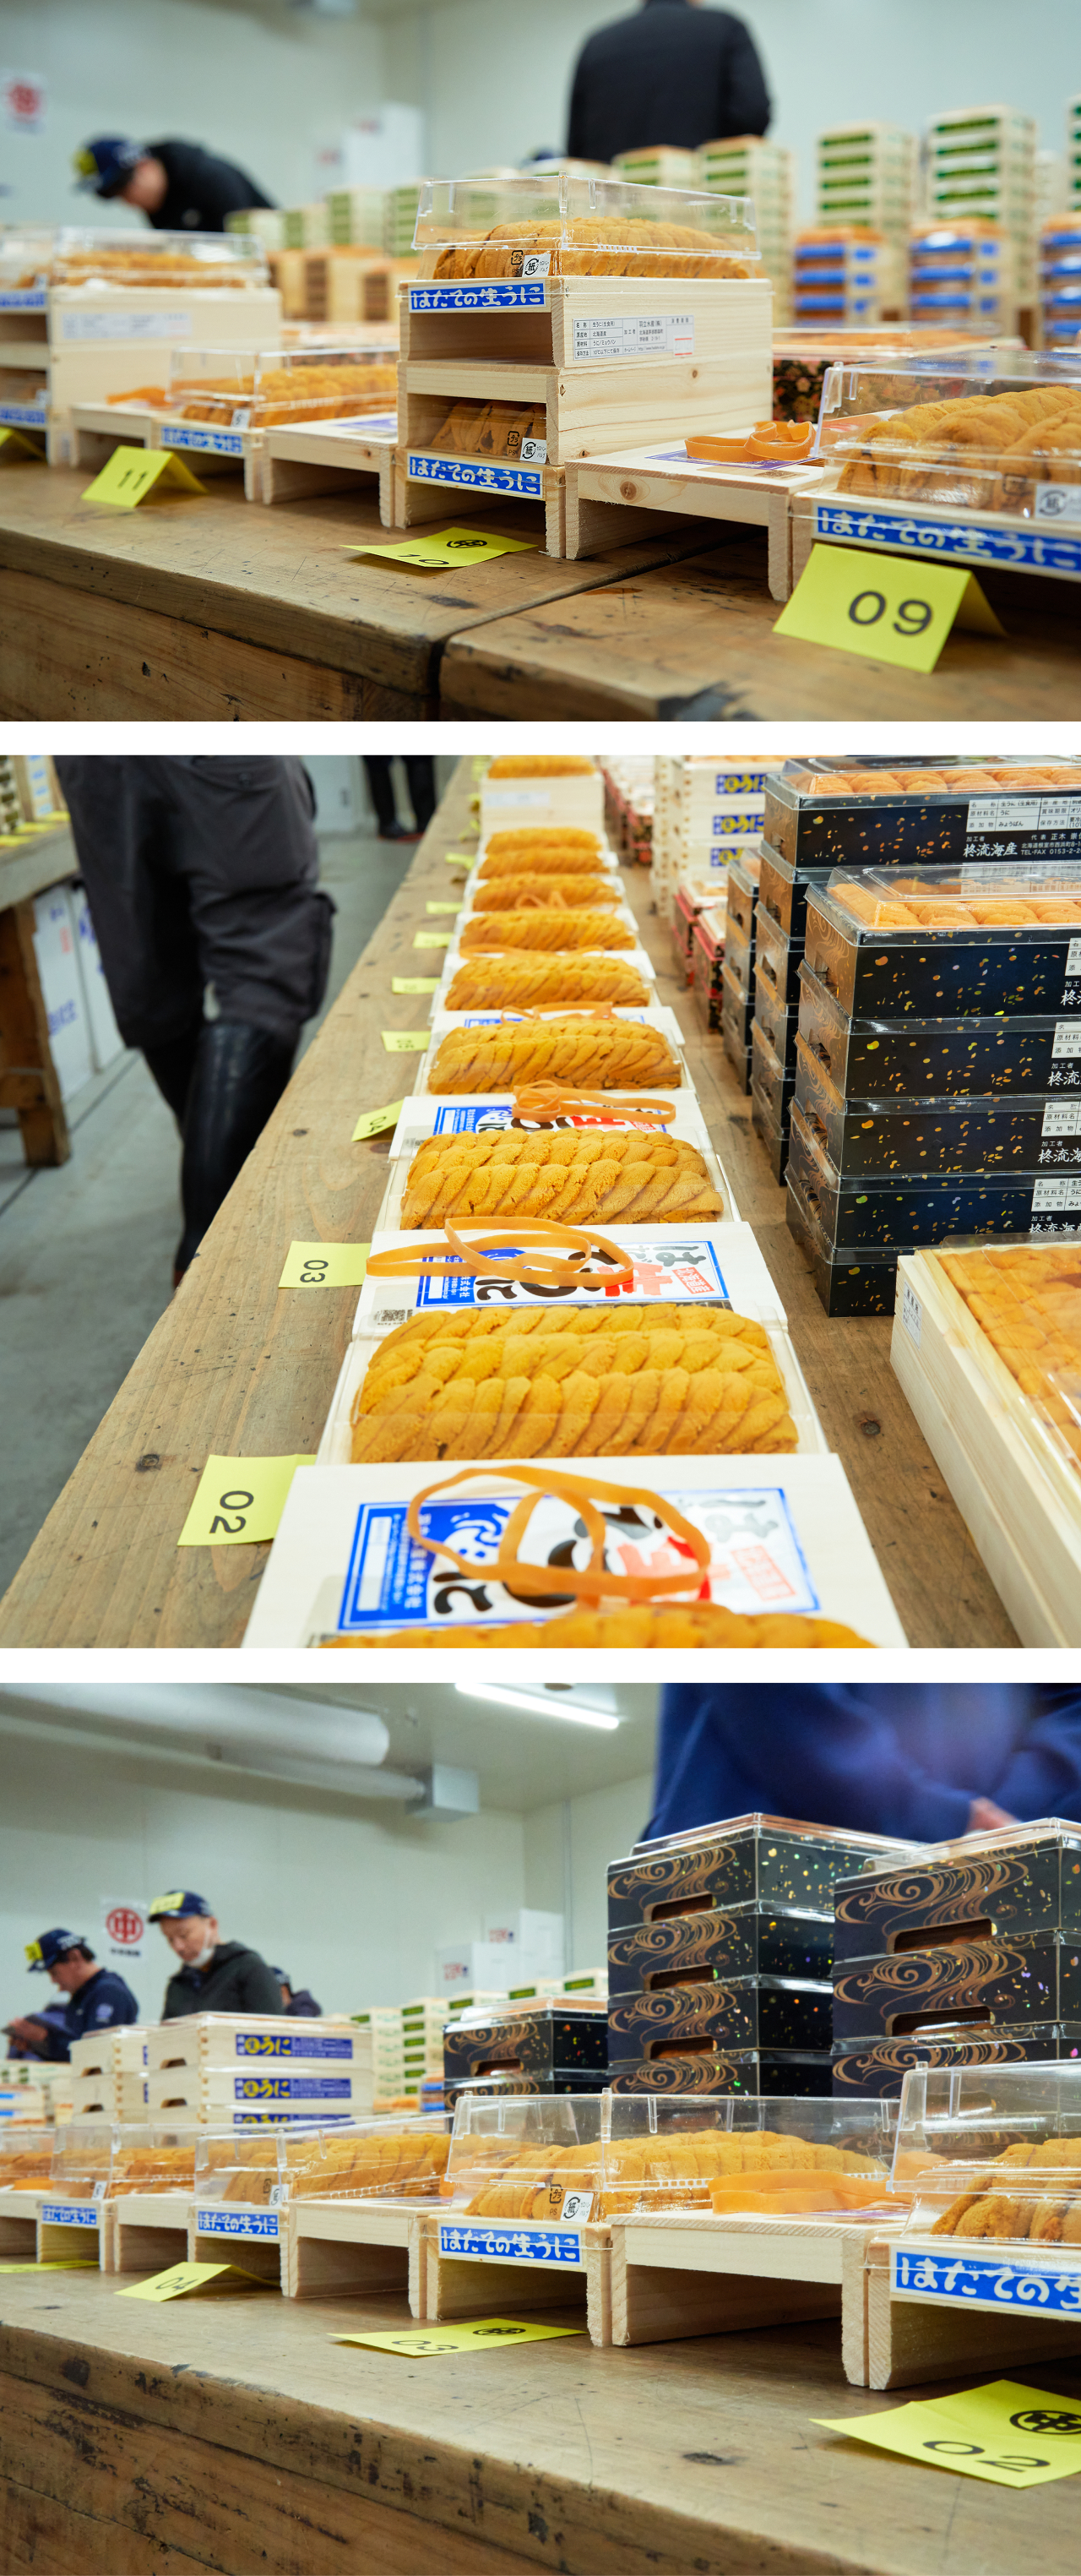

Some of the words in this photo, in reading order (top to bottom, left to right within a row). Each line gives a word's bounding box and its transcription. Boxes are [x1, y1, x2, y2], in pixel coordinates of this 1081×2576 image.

[413, 286, 541, 309] はだての生うに
[117, 467, 149, 492] 11
[411, 458, 538, 493] はだての生うに
[821, 509, 1078, 569] はだての生うに
[848, 590, 933, 636] 09
[1051, 832, 1067, 841] 正木
[963, 841, 1019, 858] 柊流海産
[1046, 1070, 1081, 1087] 柊流
[299, 1259, 329, 1283] 03
[209, 1490, 254, 1534] 02
[198, 2212, 277, 2234] はだての生うに
[550, 2208, 558, 2216] PS
[443, 2228, 577, 2260] はだての生うに
[155, 2276, 199, 2292] 04
[390, 2339, 459, 2351] 03
[921, 2440, 1051, 2474] 02
